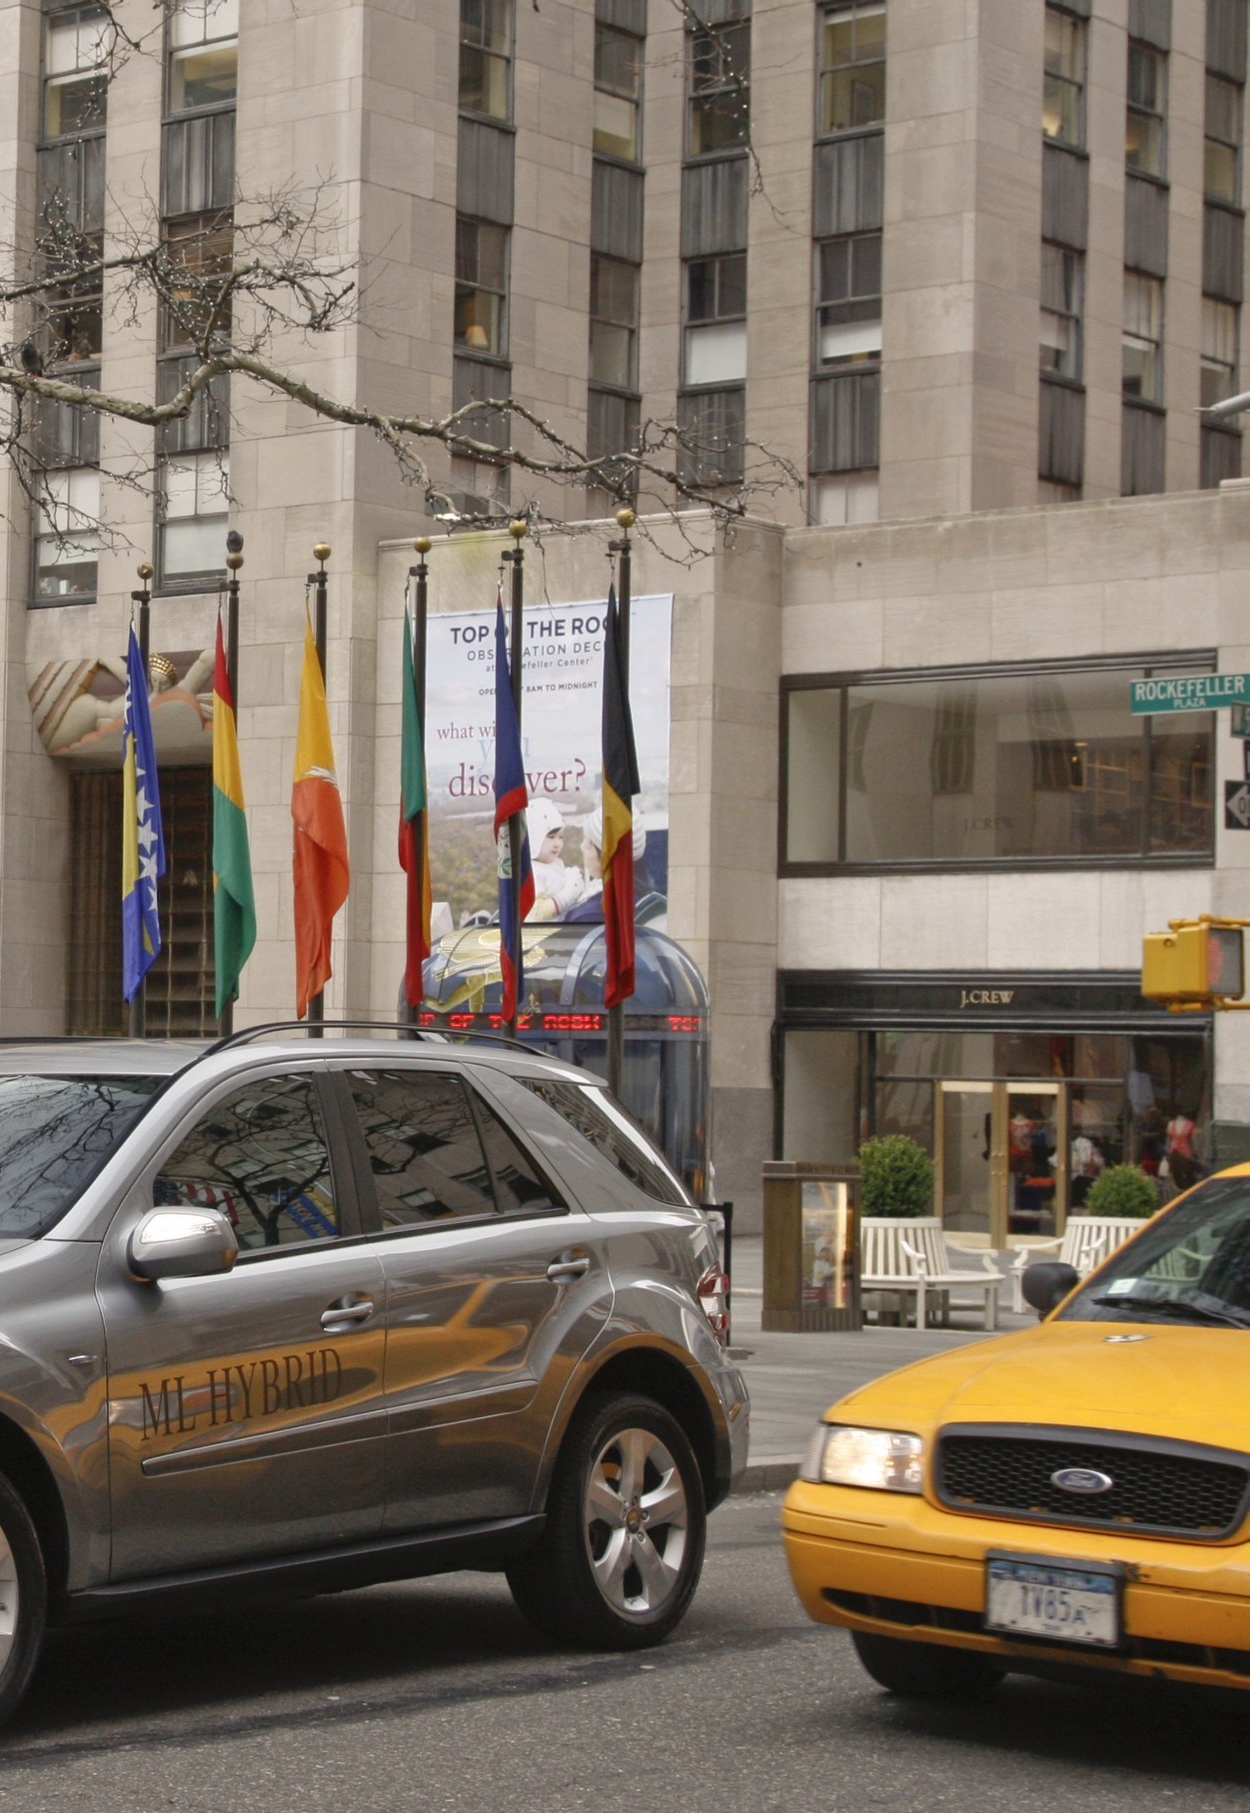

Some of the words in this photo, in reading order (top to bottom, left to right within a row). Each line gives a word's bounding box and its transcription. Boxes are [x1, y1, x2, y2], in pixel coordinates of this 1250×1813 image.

[450, 625, 490, 645] TOP
[526, 619, 566, 639] THE
[573, 640, 602, 655] DEC
[557, 658, 589, 668] Center
[478, 688, 496, 696] OPE
[545, 684, 556, 692] TO
[558, 681, 598, 690] MIDNIGHT
[1135, 676, 1245, 701] ROCKEFELLER
[1173, 697, 1206, 709] PLAZA
[437, 722, 475, 740] what
[479, 721, 496, 739] wi
[448, 758, 587, 797] disver?
[960, 990, 1014, 1009] J.CREW
[488, 1014, 531, 1030] TE
[138, 1375, 196, 1442] ML
[207, 1348, 343, 1427] HYBRID
